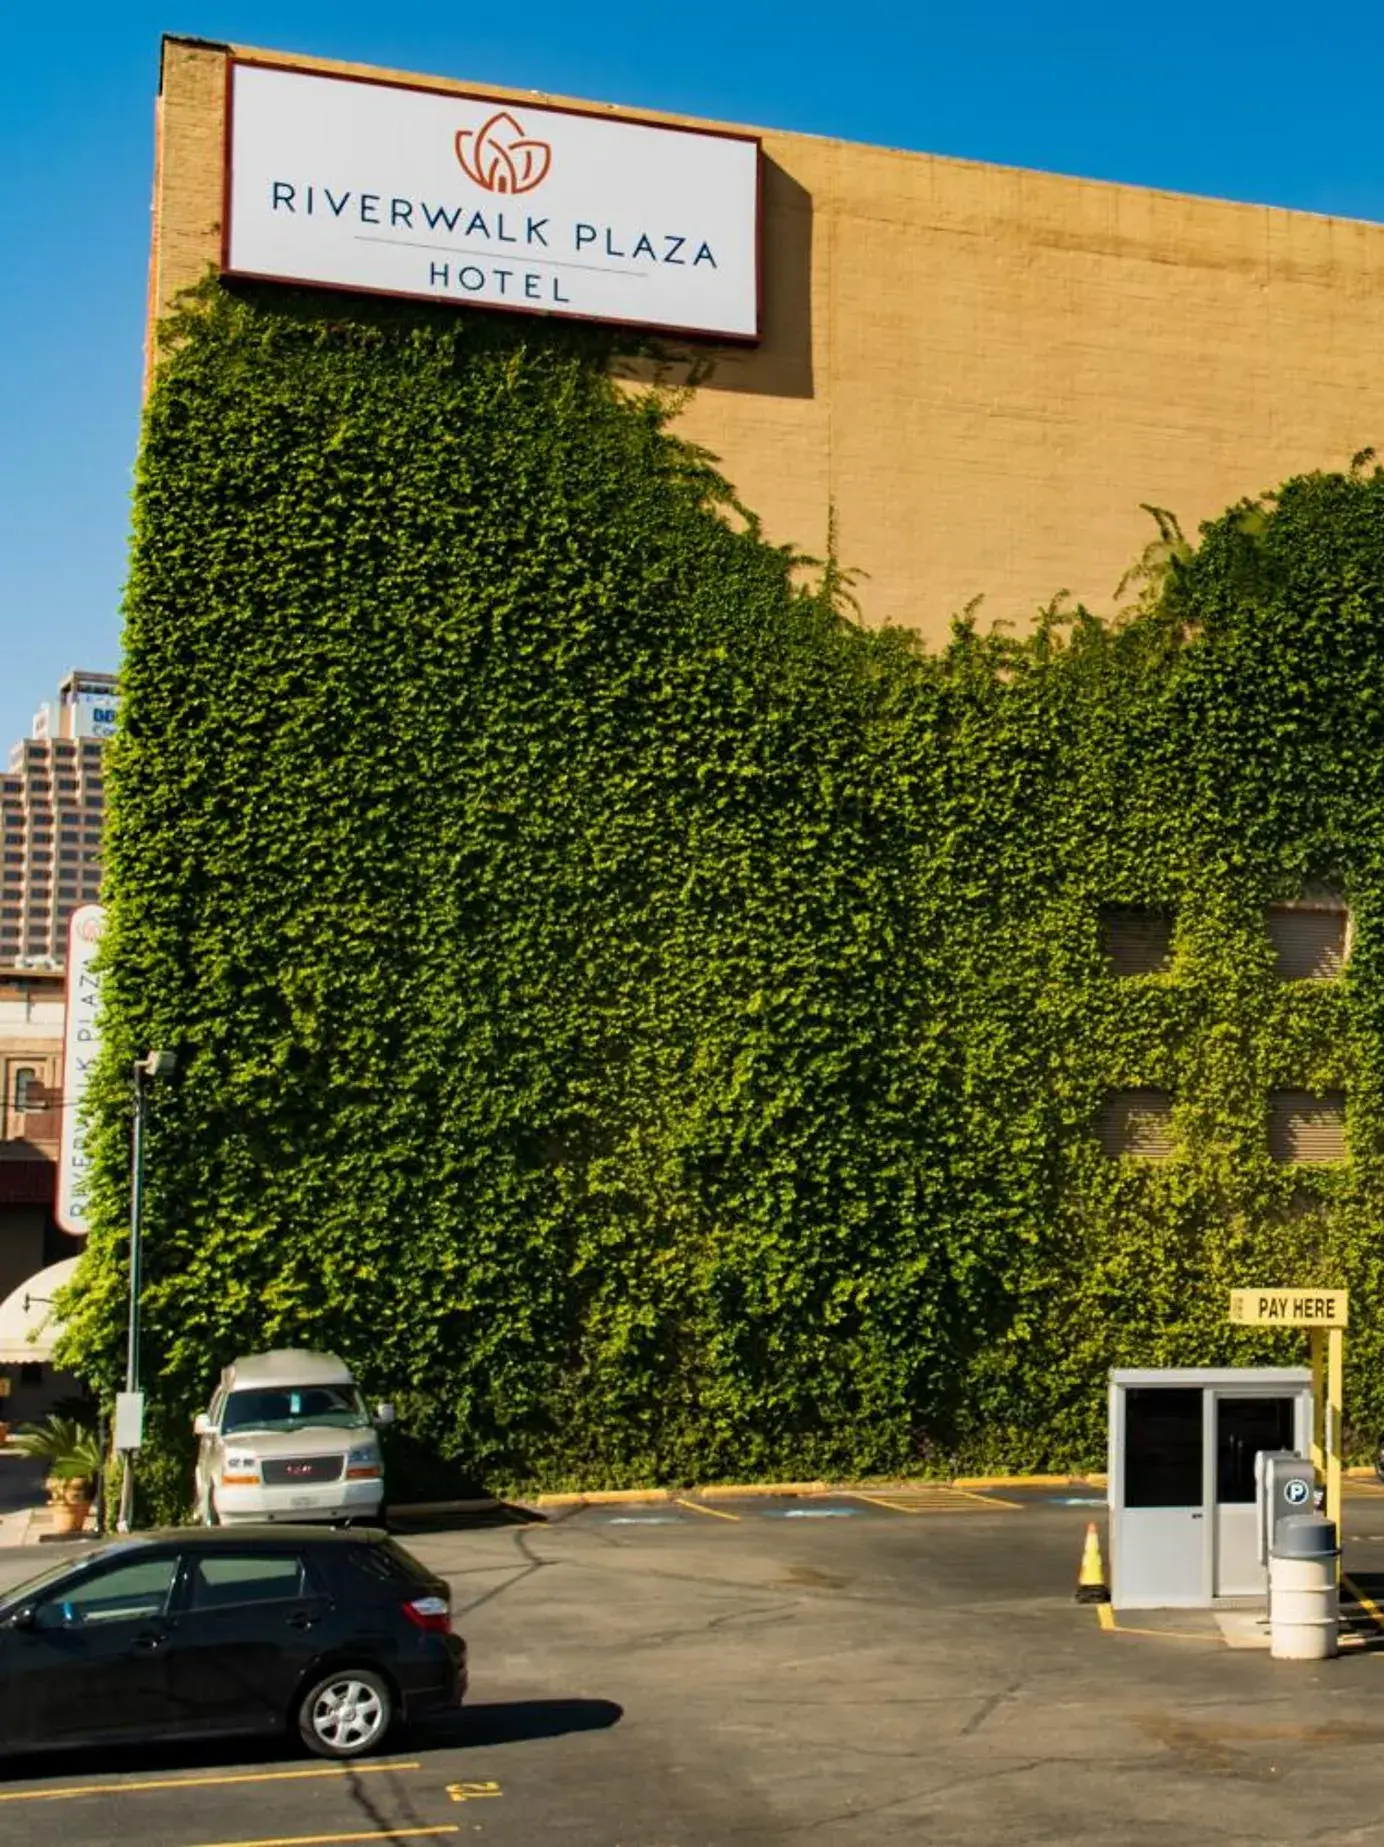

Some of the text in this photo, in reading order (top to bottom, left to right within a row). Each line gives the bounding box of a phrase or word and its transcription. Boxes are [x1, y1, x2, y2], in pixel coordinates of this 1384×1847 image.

[272, 181, 718, 268] RIVERWALK PLAZA
[430, 261, 570, 303] HOTEL
[1259, 1297, 1288, 1318] PAY
[1293, 1297, 1336, 1319] HERE
[1290, 1483, 1304, 1501] P
